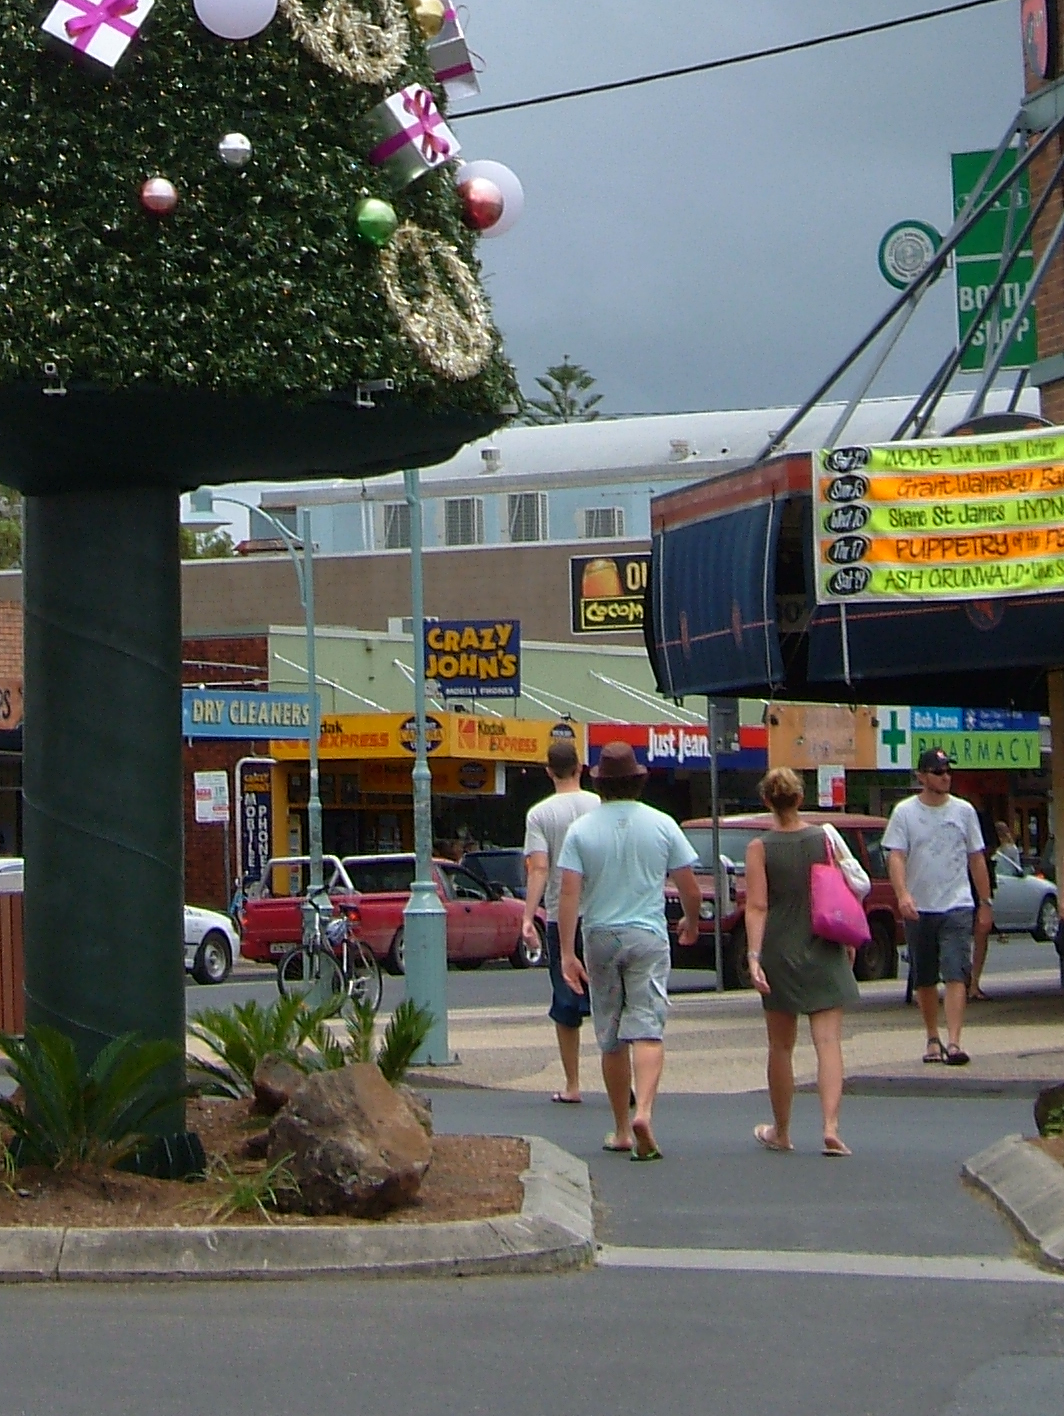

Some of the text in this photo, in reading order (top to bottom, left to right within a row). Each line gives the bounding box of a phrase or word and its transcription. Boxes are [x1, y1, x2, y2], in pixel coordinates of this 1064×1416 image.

[889, 508, 927, 528] Shane
[933, 506, 954, 526] St
[959, 504, 1005, 525] James
[896, 533, 1009, 559] PUPPETRY
[886, 570, 923, 590] ASH
[427, 623, 514, 653] CRAZY
[425, 649, 517, 680] JOHN'S
[446, 686, 514, 696] MOBILE PHONES
[192, 697, 309, 726] DRY CLEANERS
[320, 721, 343, 734] dak
[478, 720, 507, 736] Kodak
[320, 732, 390, 749] EXPRESS
[489, 736, 538, 753] EXPRESS
[647, 726, 712, 764] Just Jean
[244, 792, 257, 867] MOBILE
